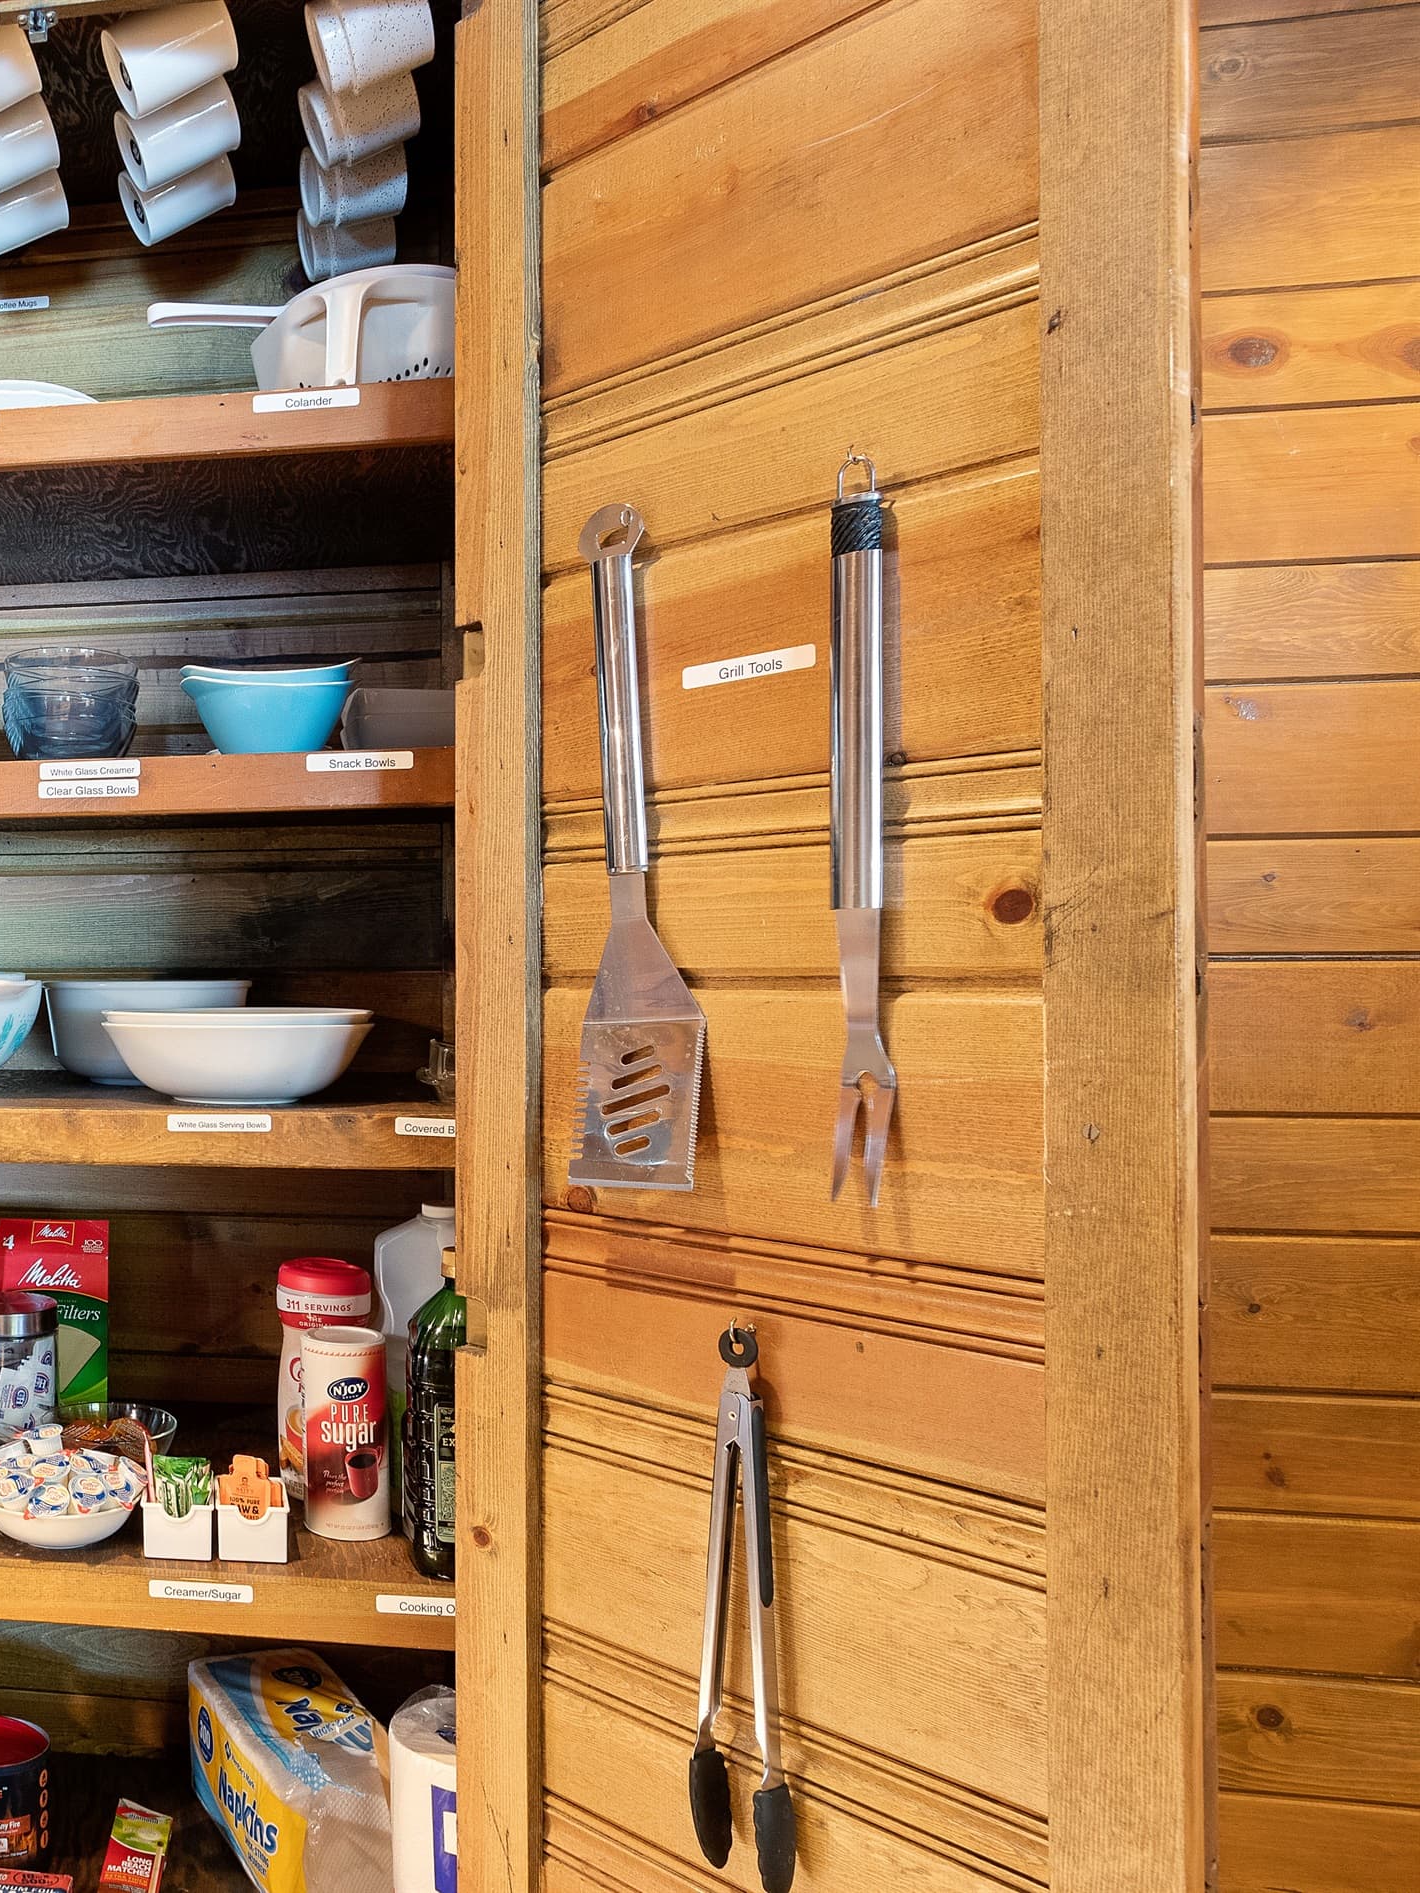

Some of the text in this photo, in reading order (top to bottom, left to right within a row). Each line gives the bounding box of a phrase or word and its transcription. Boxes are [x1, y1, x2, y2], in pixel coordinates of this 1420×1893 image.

[18, 299, 38, 308] Mugs
[285, 396, 333, 409] Colander
[718, 659, 783, 680] Grill Tools
[329, 757, 396, 770] Snack Bowls
[50, 765, 135, 777] White Glass Creamer
[46, 784, 136, 797] Clear Glass Bowls
[177, 1121, 267, 1131] White Glass Serving Bowls
[404, 1122, 455, 1135] Covered B
[36, 1223, 70, 1239] Melitta
[17, 1257, 83, 1288] Melitta
[286, 1298, 352, 1312] 311 SERVINGS
[56, 1304, 101, 1321] Filters
[331, 1404, 369, 1422] PURE
[320, 1421, 377, 1453] sugar
[442, 1437, 456, 1447] EX
[247, 1498, 260, 1506] PURE
[251, 1506, 260, 1515] &
[164, 1585, 242, 1602] Creamer/Sugar
[399, 1601, 456, 1616] Cooking O
[218, 1766, 278, 1855] Napkins
[9, 1819, 21, 1829] Fire
[121, 1860, 152, 1872] REACH
[127, 1855, 153, 1866] LONG
[107, 1864, 151, 1878] MATCHES
